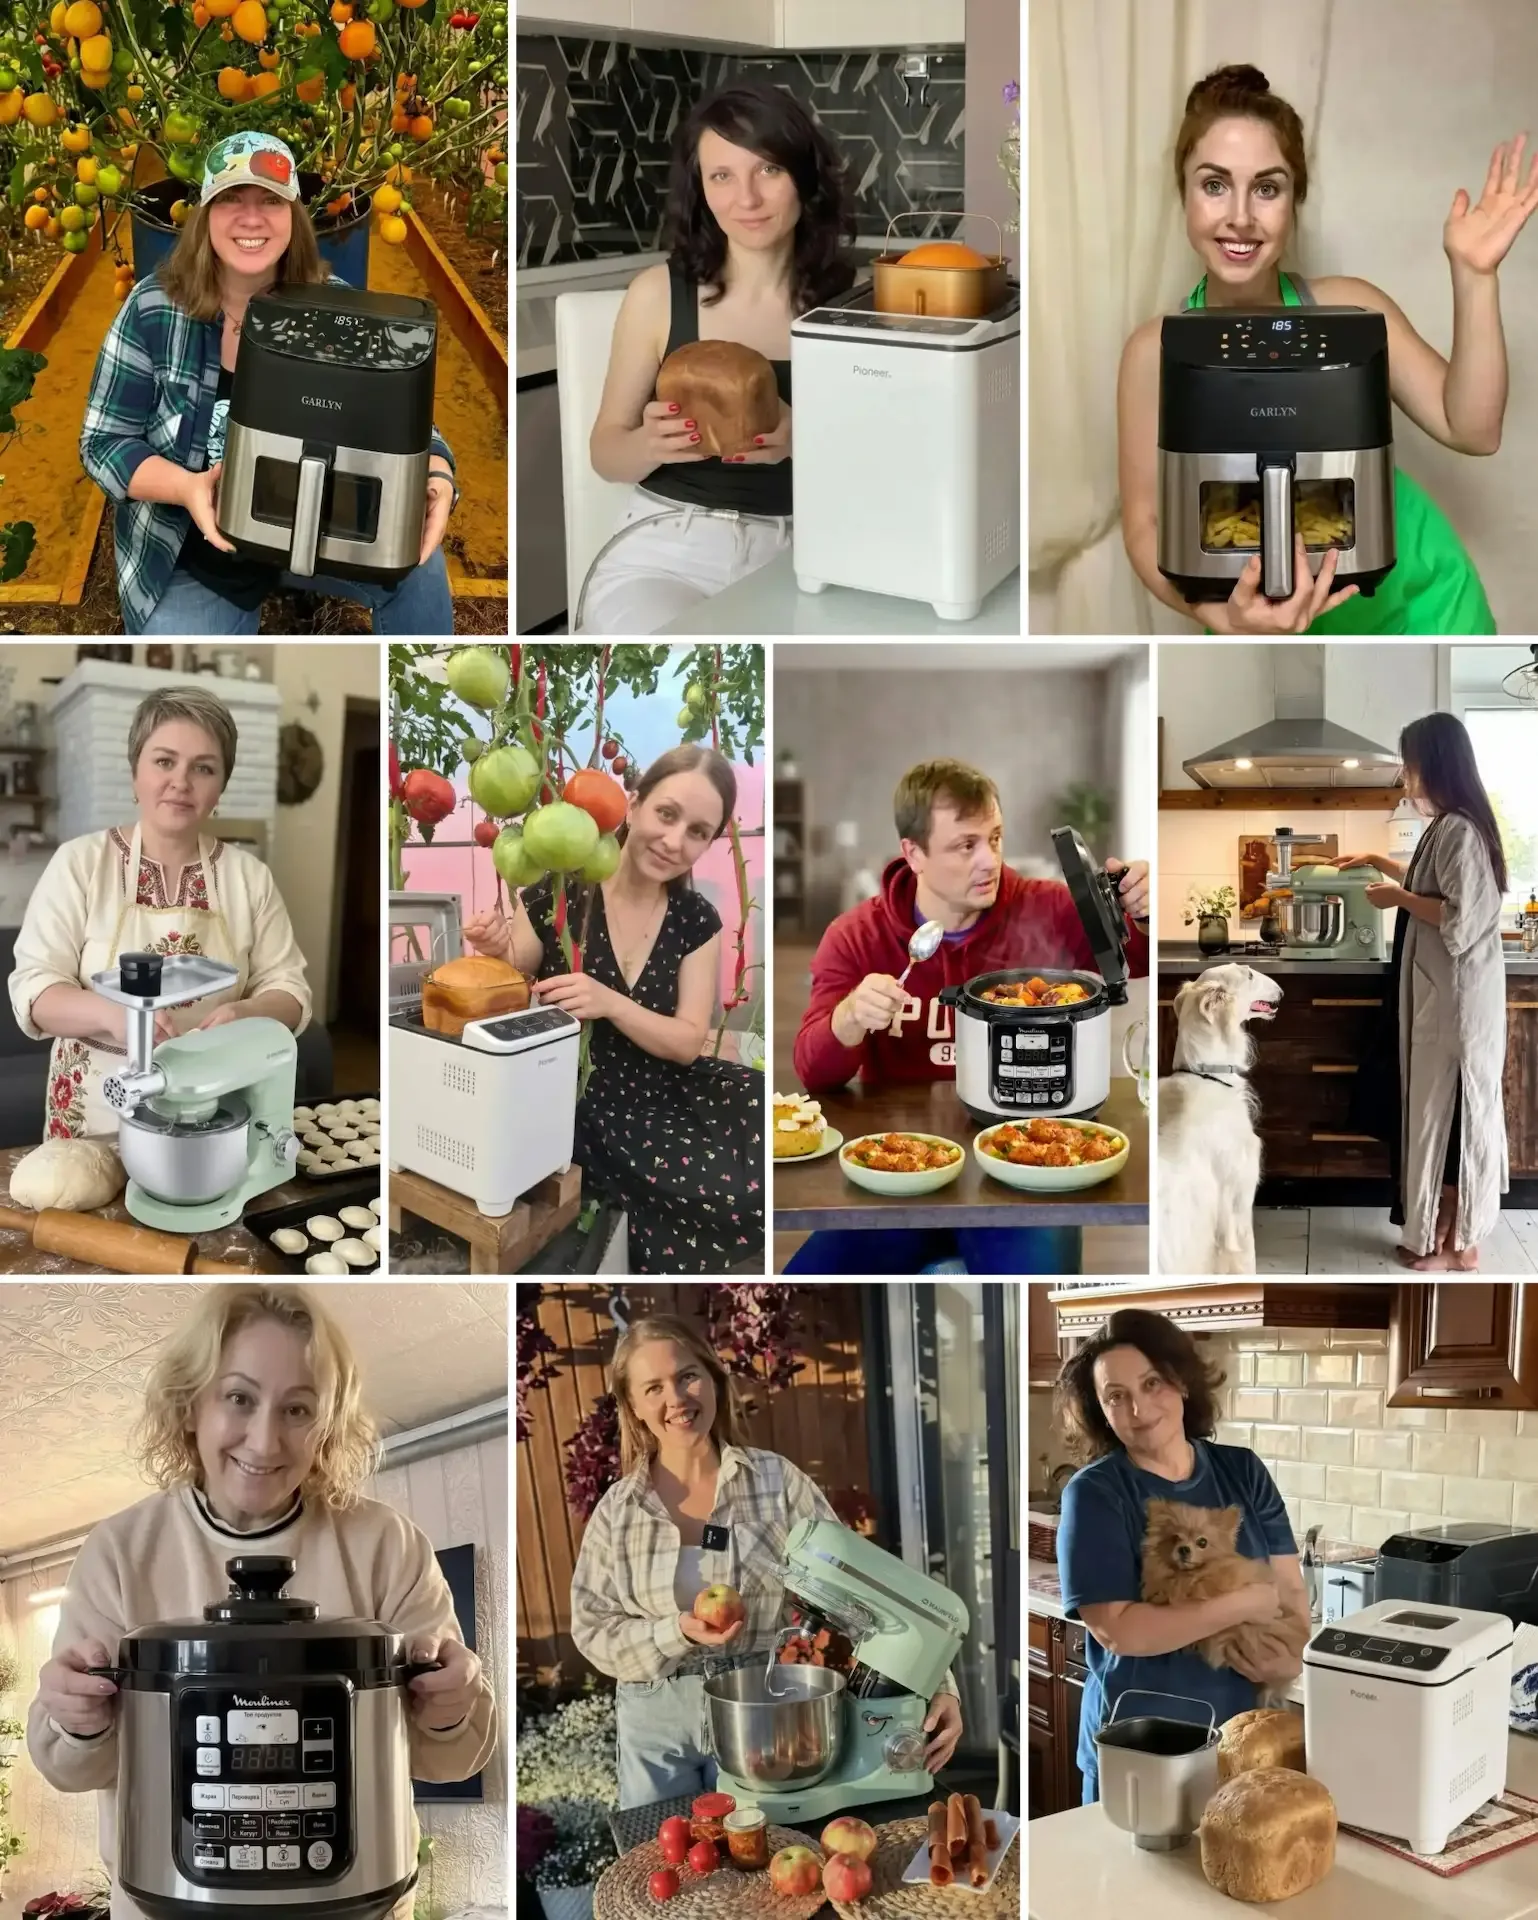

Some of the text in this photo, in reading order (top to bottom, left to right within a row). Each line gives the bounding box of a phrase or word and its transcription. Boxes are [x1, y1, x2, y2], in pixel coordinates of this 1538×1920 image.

[1272, 321, 1292, 330] 185
[853, 365, 890, 378] Pioneer
[301, 396, 343, 411] GARLYN
[1250, 407, 1297, 417] GARLYN
[233, 1694, 291, 1707] Moulinex
